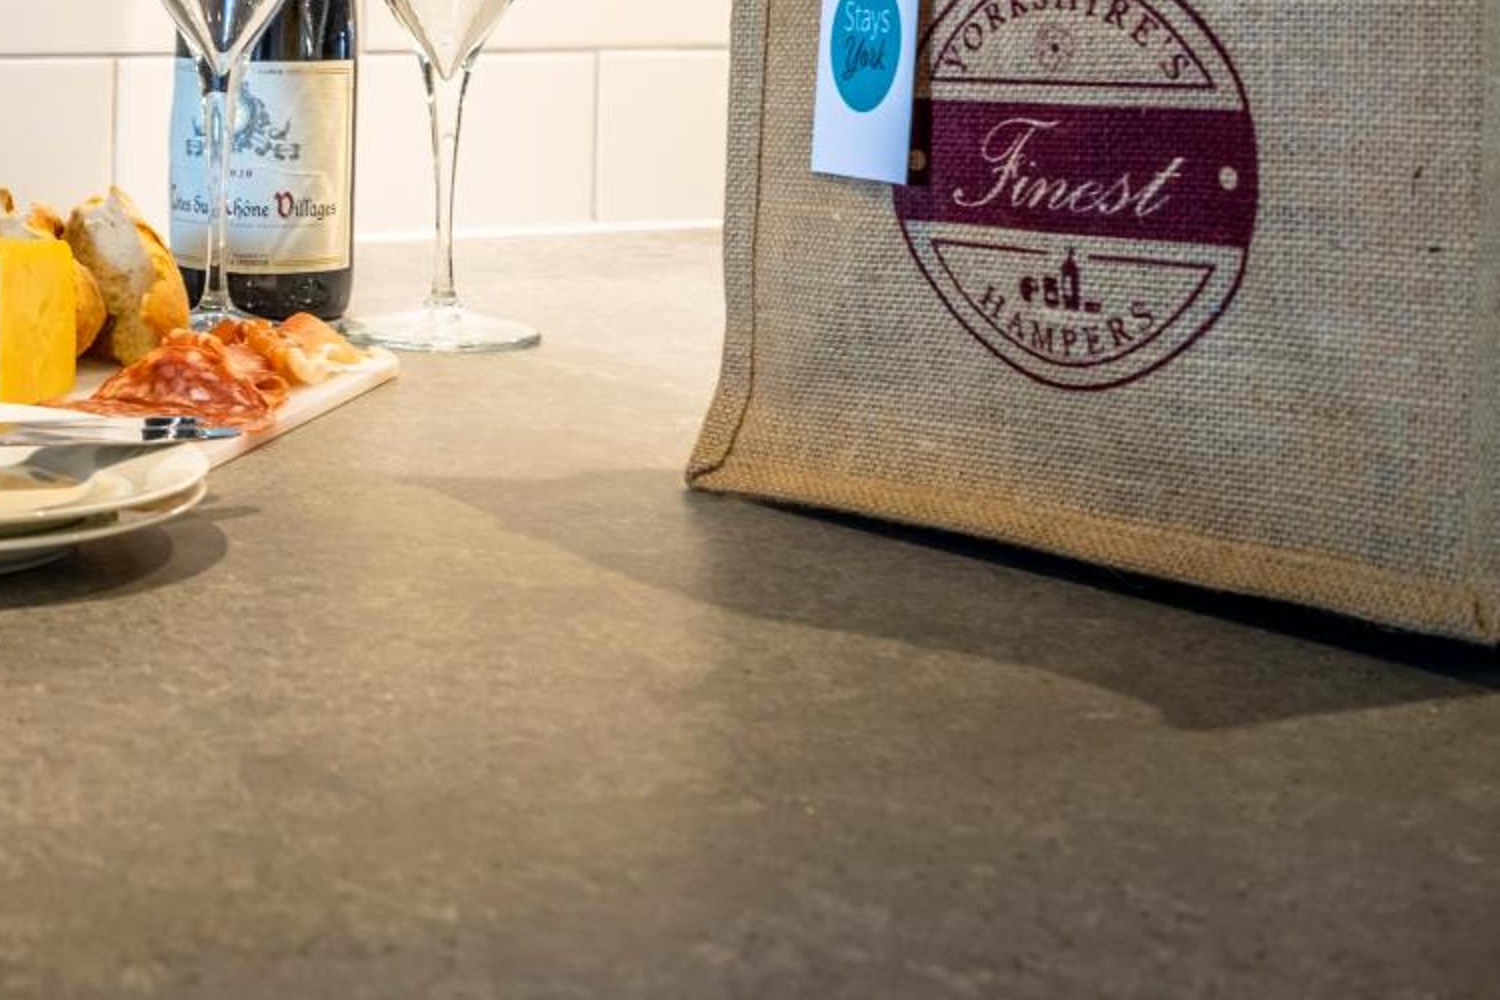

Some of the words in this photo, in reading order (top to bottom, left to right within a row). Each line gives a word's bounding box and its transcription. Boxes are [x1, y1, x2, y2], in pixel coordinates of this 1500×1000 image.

[843, 0, 891, 41] Stays
[841, 35, 886, 81] York
[953, 117, 1186, 217] Finest
[274, 190, 337, 221] Villages
[978, 285, 1154, 356] HAMPERS
